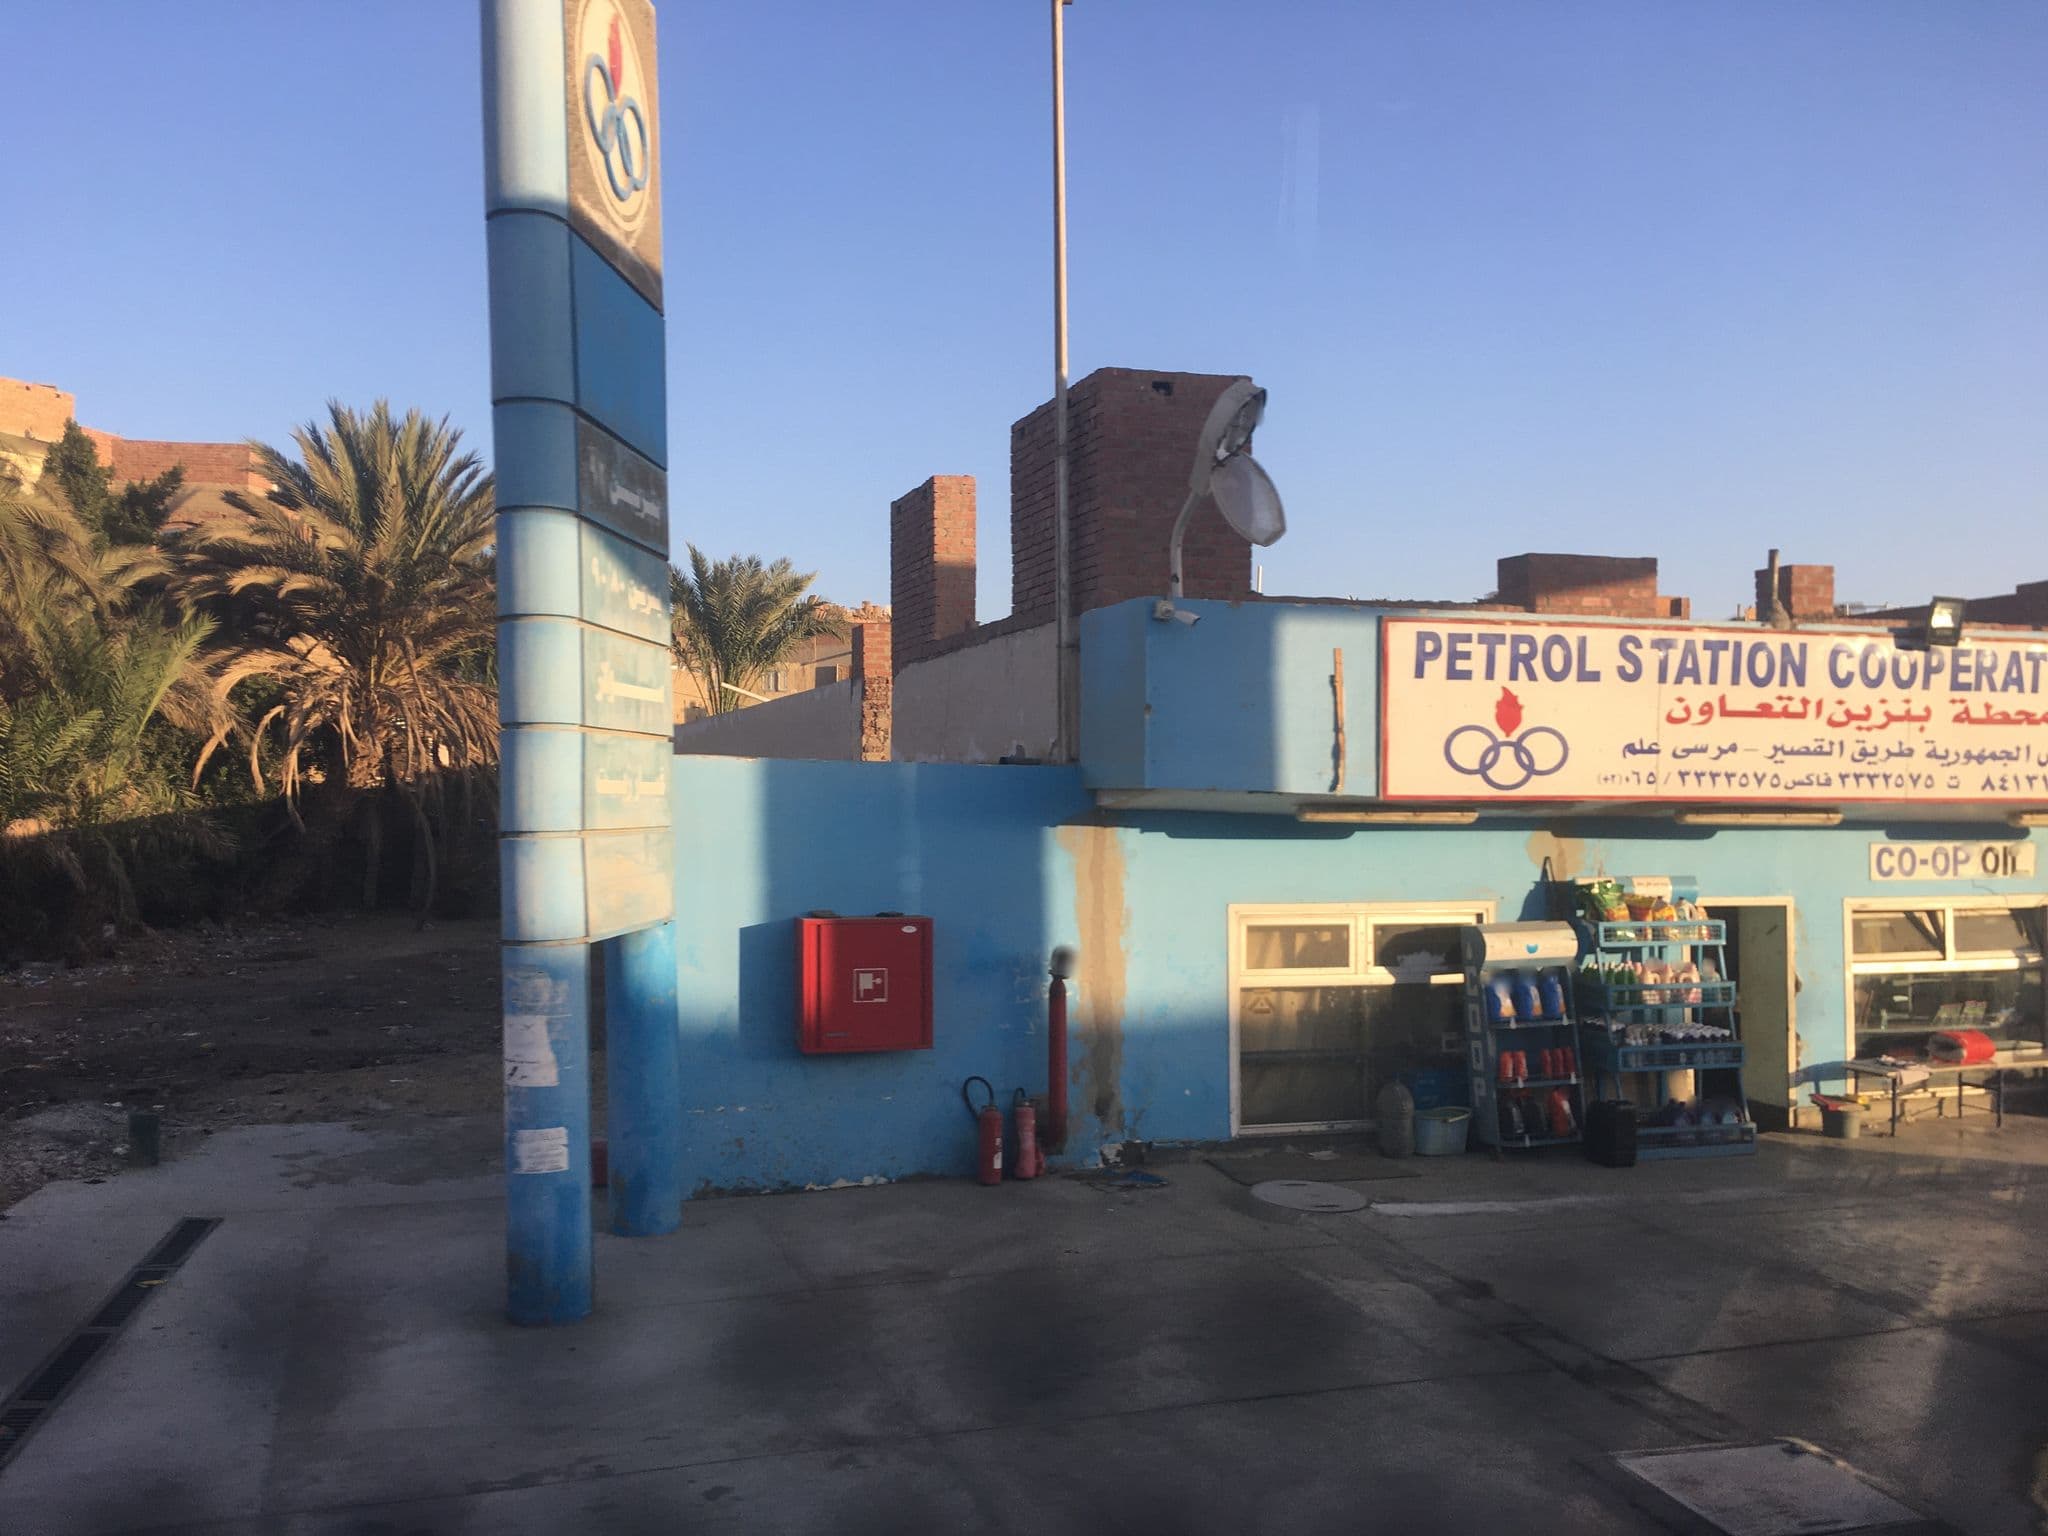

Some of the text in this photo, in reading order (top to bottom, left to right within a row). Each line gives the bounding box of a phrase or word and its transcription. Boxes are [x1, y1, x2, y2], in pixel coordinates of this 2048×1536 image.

[1414, 630, 1602, 683] PETROL
[1616, 633, 1809, 689] STATION
[1664, 693, 1824, 726] التعاون
[1825, 697, 1933, 733] بنزين
[1764, 737, 1845, 764] القصير
[1850, 739, 1916, 765] طريق
[1924, 739, 2031, 767] الجمهورية
[1876, 846, 1971, 878] CO-OP
